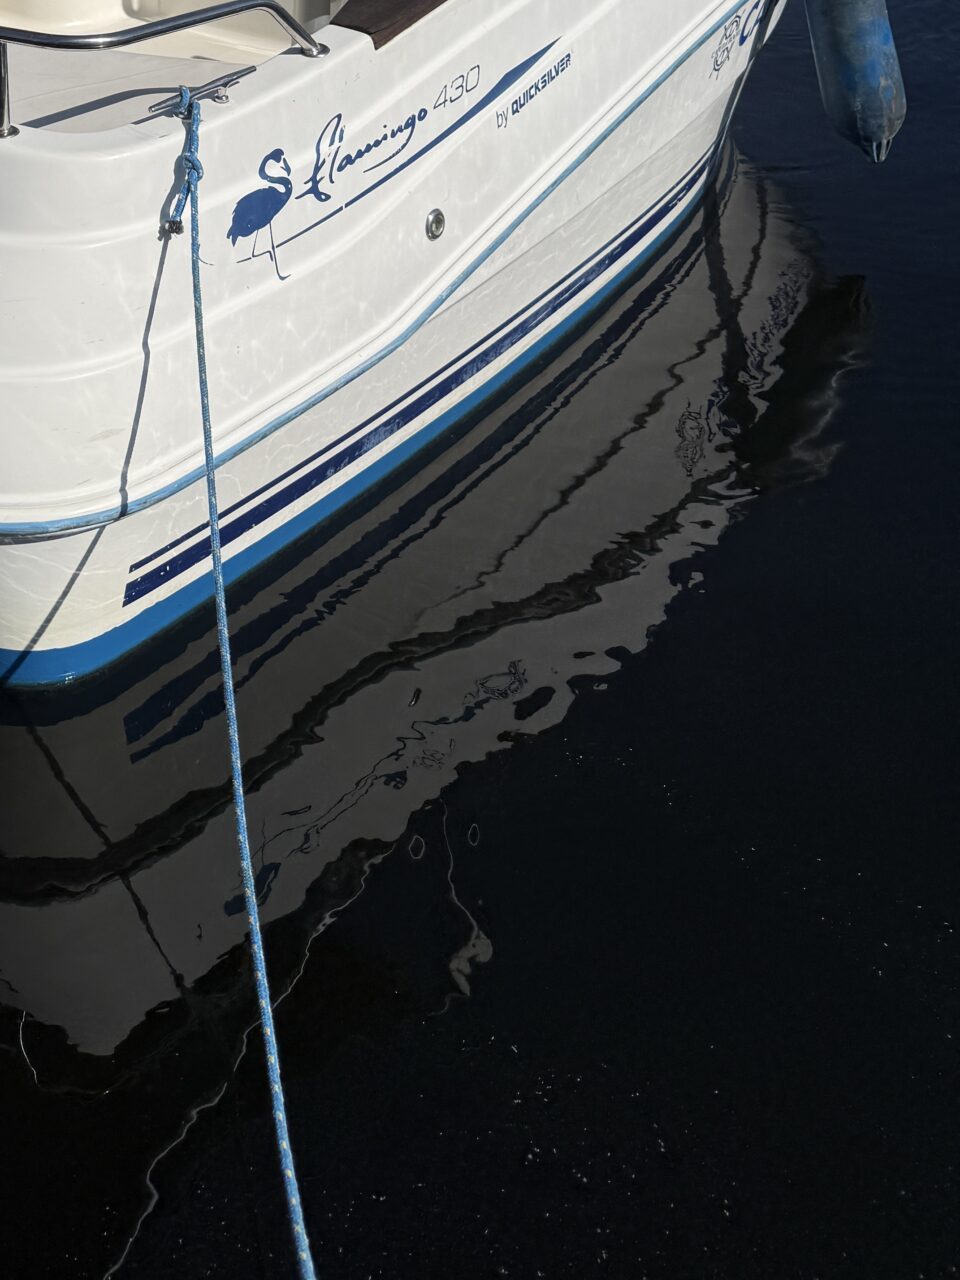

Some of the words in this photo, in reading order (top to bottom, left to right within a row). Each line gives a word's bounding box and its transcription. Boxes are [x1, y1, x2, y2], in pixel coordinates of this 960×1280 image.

[433, 64, 480, 109] 430
[495, 106, 509, 129] by
[511, 52, 572, 116] QUICKSILVER
